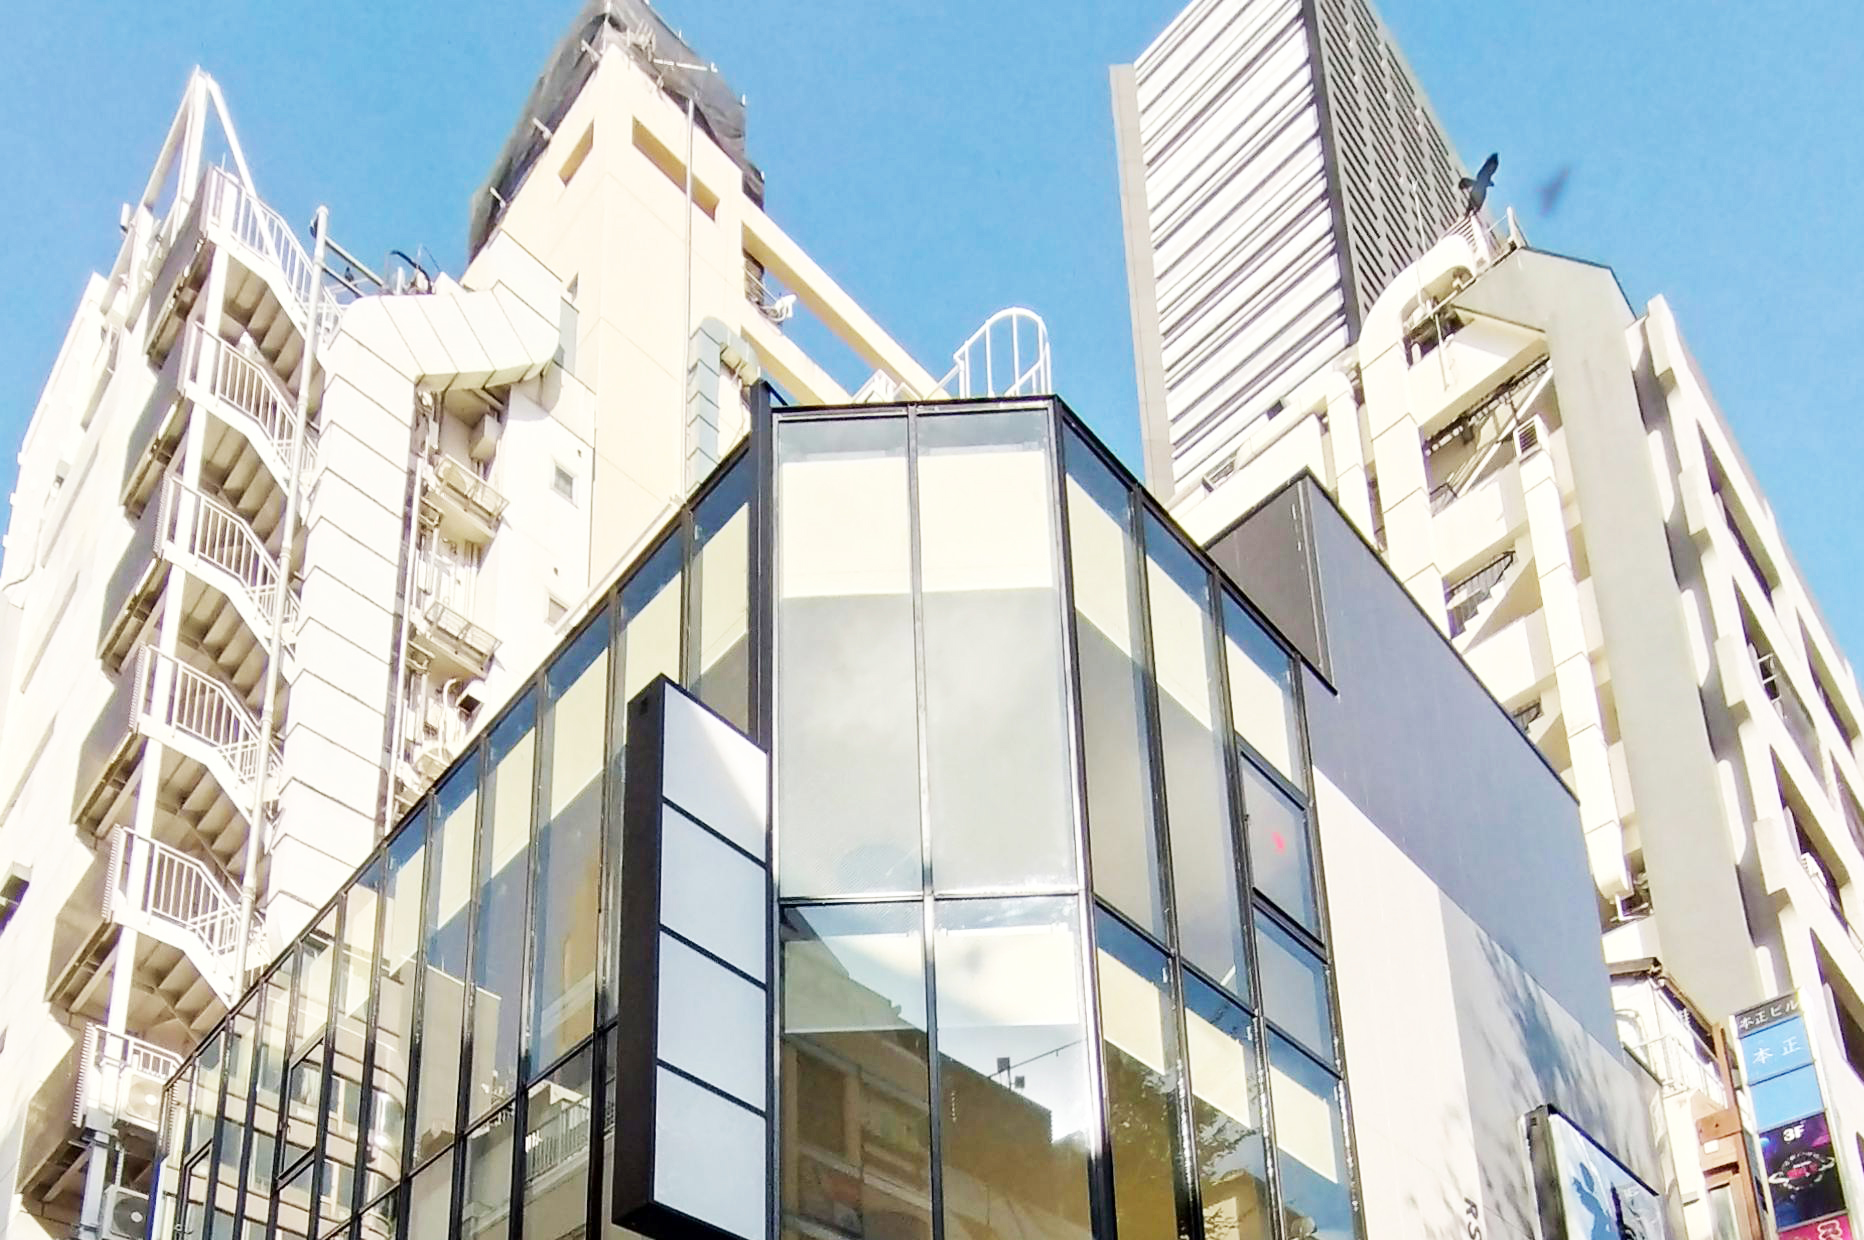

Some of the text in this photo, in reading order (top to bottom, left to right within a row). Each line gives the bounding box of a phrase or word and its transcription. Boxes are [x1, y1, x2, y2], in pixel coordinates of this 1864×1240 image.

[1739, 1000, 1800, 1029] 本正ビル
[1752, 1036, 1801, 1064] 本正
[1782, 1123, 1806, 1142] 3F
